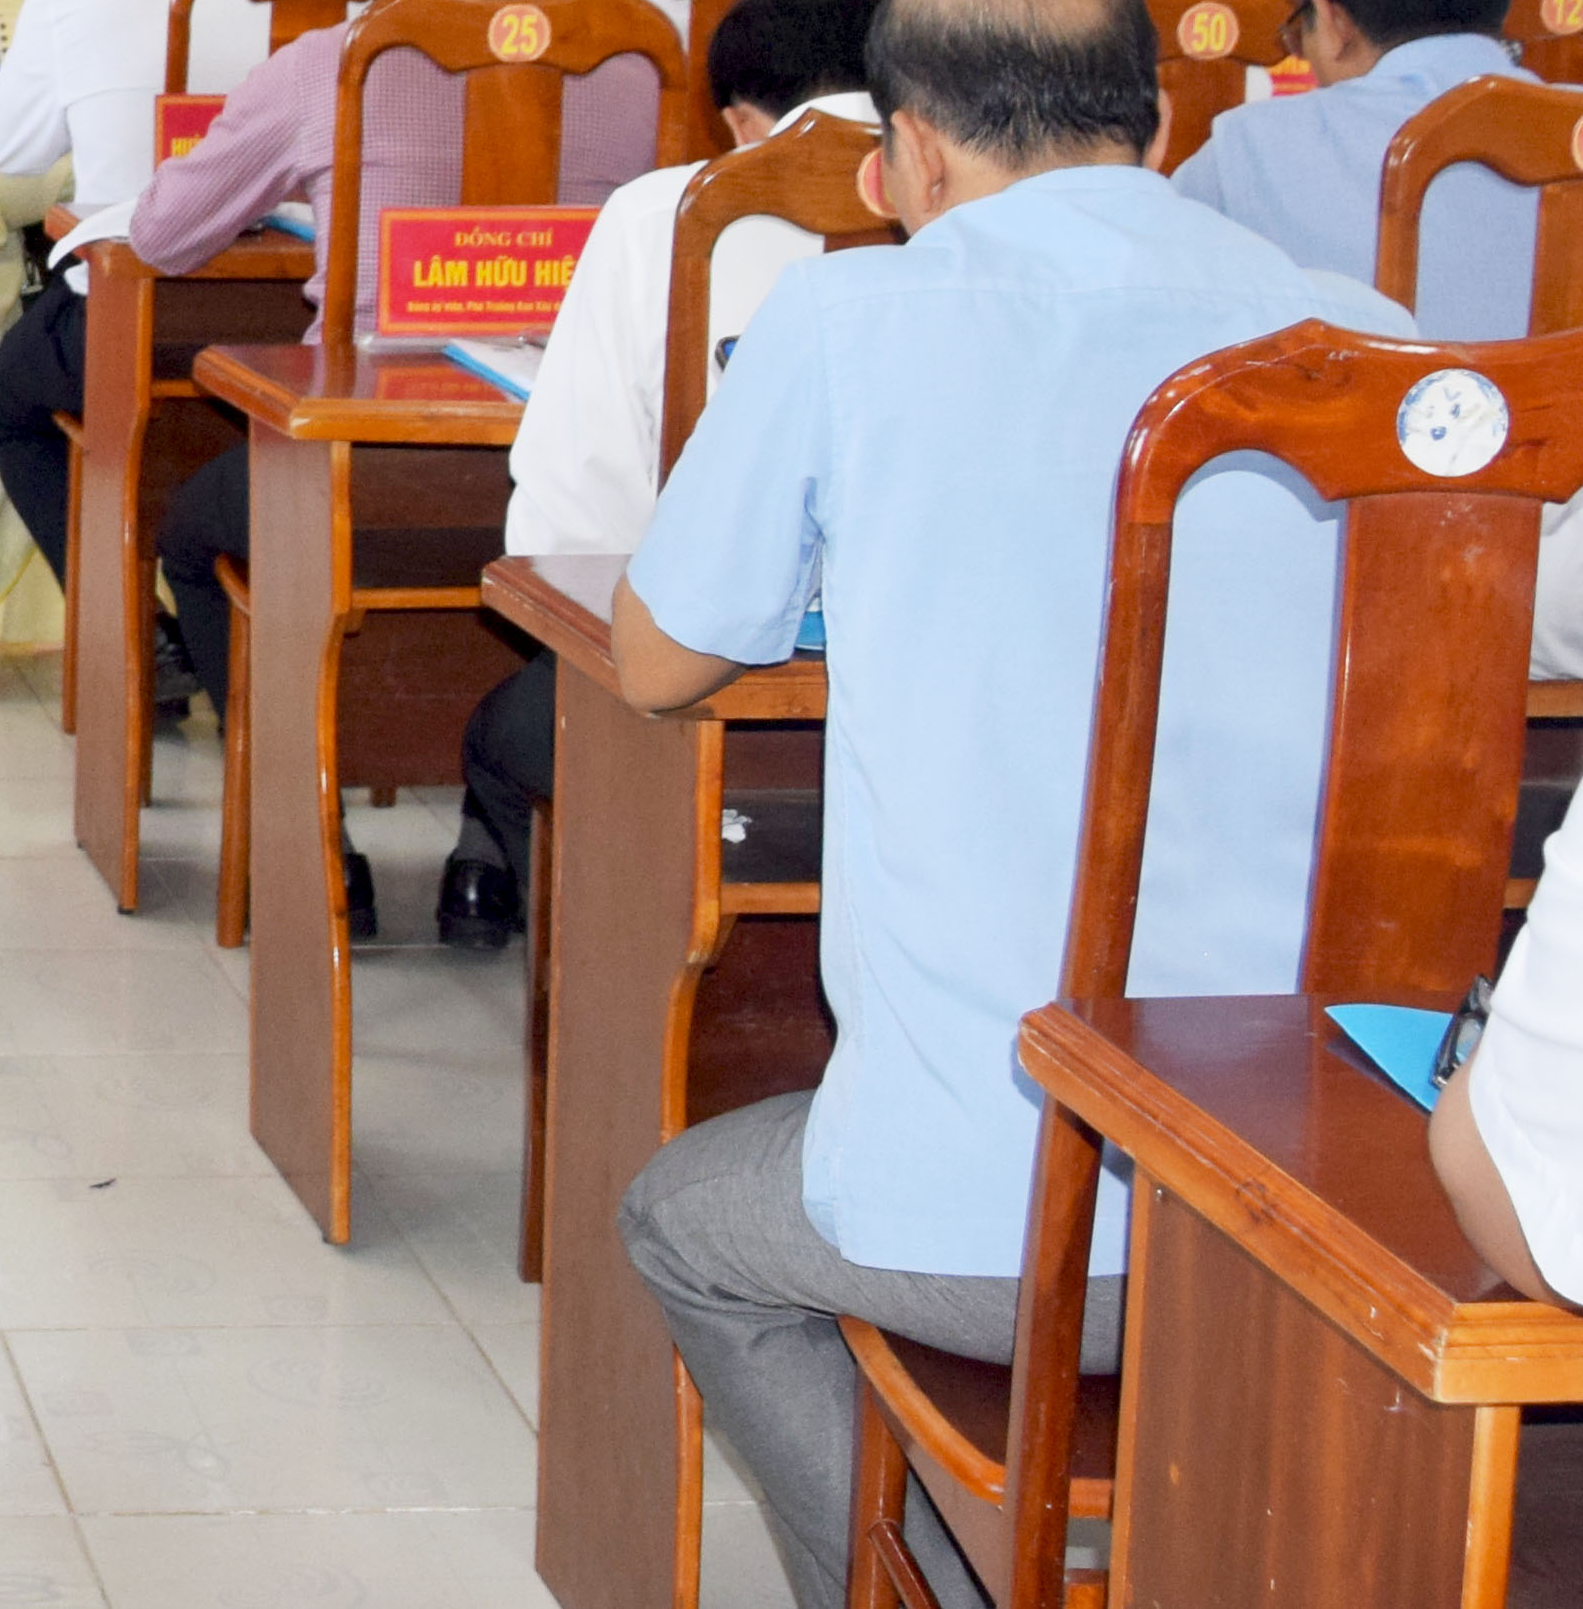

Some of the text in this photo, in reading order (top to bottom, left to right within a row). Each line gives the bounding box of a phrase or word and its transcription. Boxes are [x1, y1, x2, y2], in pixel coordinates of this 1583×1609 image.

[501, 14, 538, 57] 25
[1187, 12, 1227, 53] 50
[455, 226, 553, 247] ĐỒNG CHÍ
[413, 255, 528, 287] LÂM HỮU
